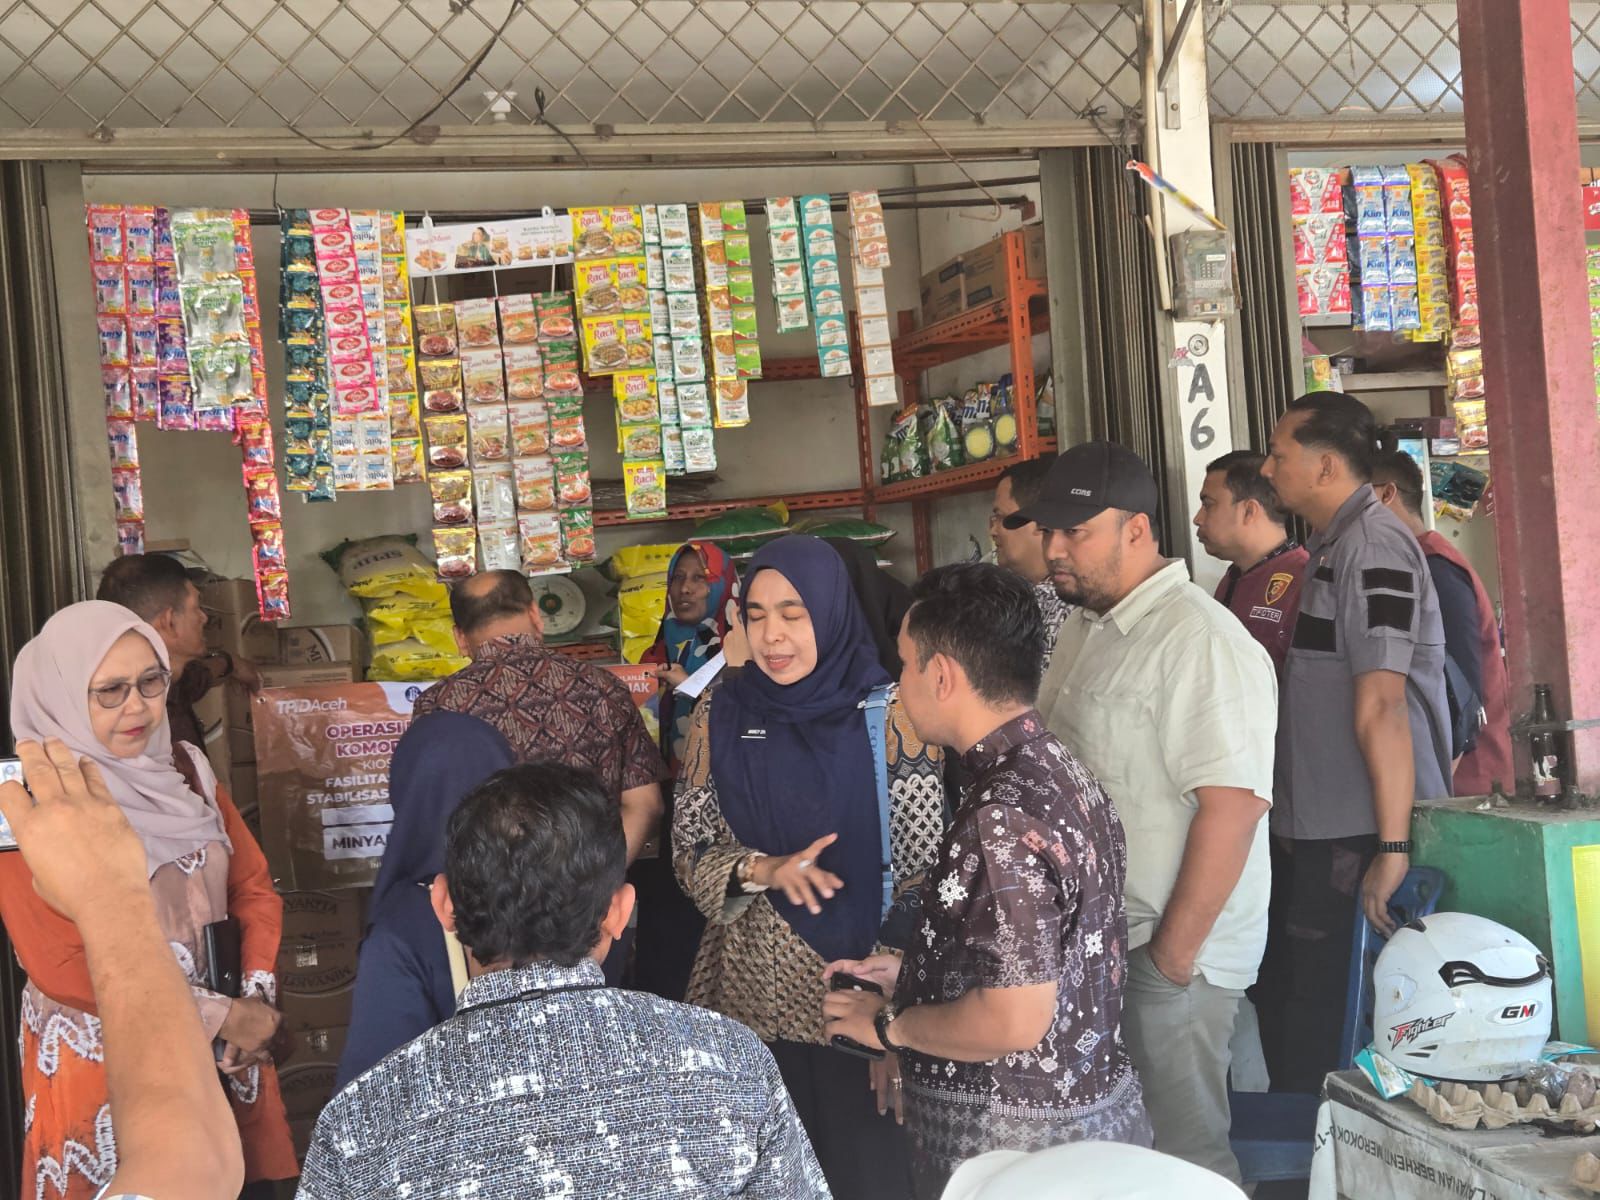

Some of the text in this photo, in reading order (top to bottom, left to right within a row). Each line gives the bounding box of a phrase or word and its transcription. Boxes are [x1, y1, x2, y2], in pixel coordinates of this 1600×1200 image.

[1363, 208, 1382, 218] Klin
[1392, 208, 1410, 217] Klin
[326, 721, 402, 738] OPERASI
[325, 773, 390, 788] FASILITA
[1501, 1003, 1536, 1019] GM
[1390, 1011, 1456, 1050] Fighter
